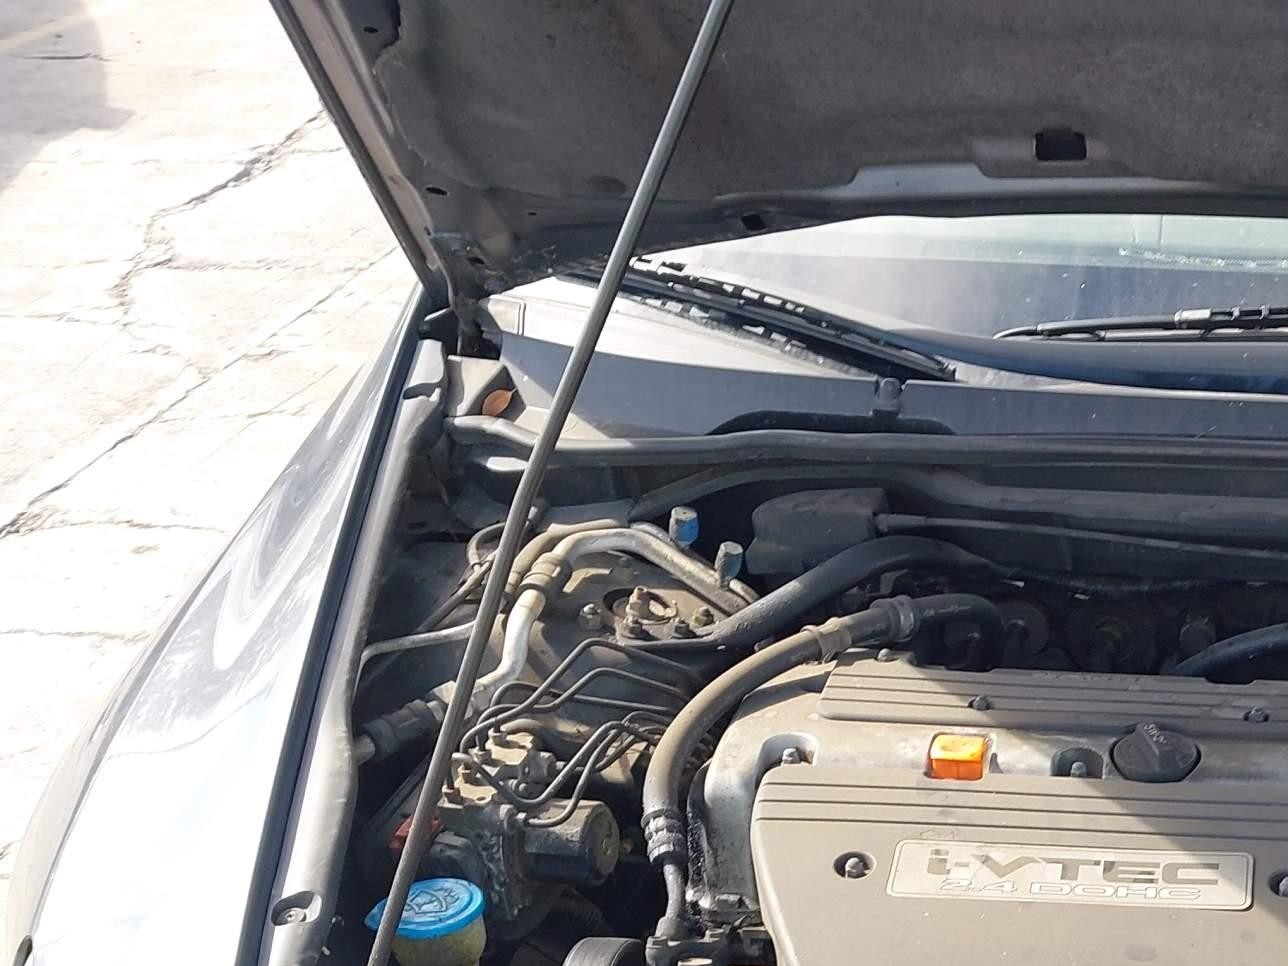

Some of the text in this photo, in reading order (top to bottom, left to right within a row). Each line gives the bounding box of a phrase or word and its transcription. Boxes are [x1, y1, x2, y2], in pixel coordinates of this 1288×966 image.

[927, 849, 1220, 885] i-VTEC
[939, 878, 1202, 900] 2.4 DOHC
